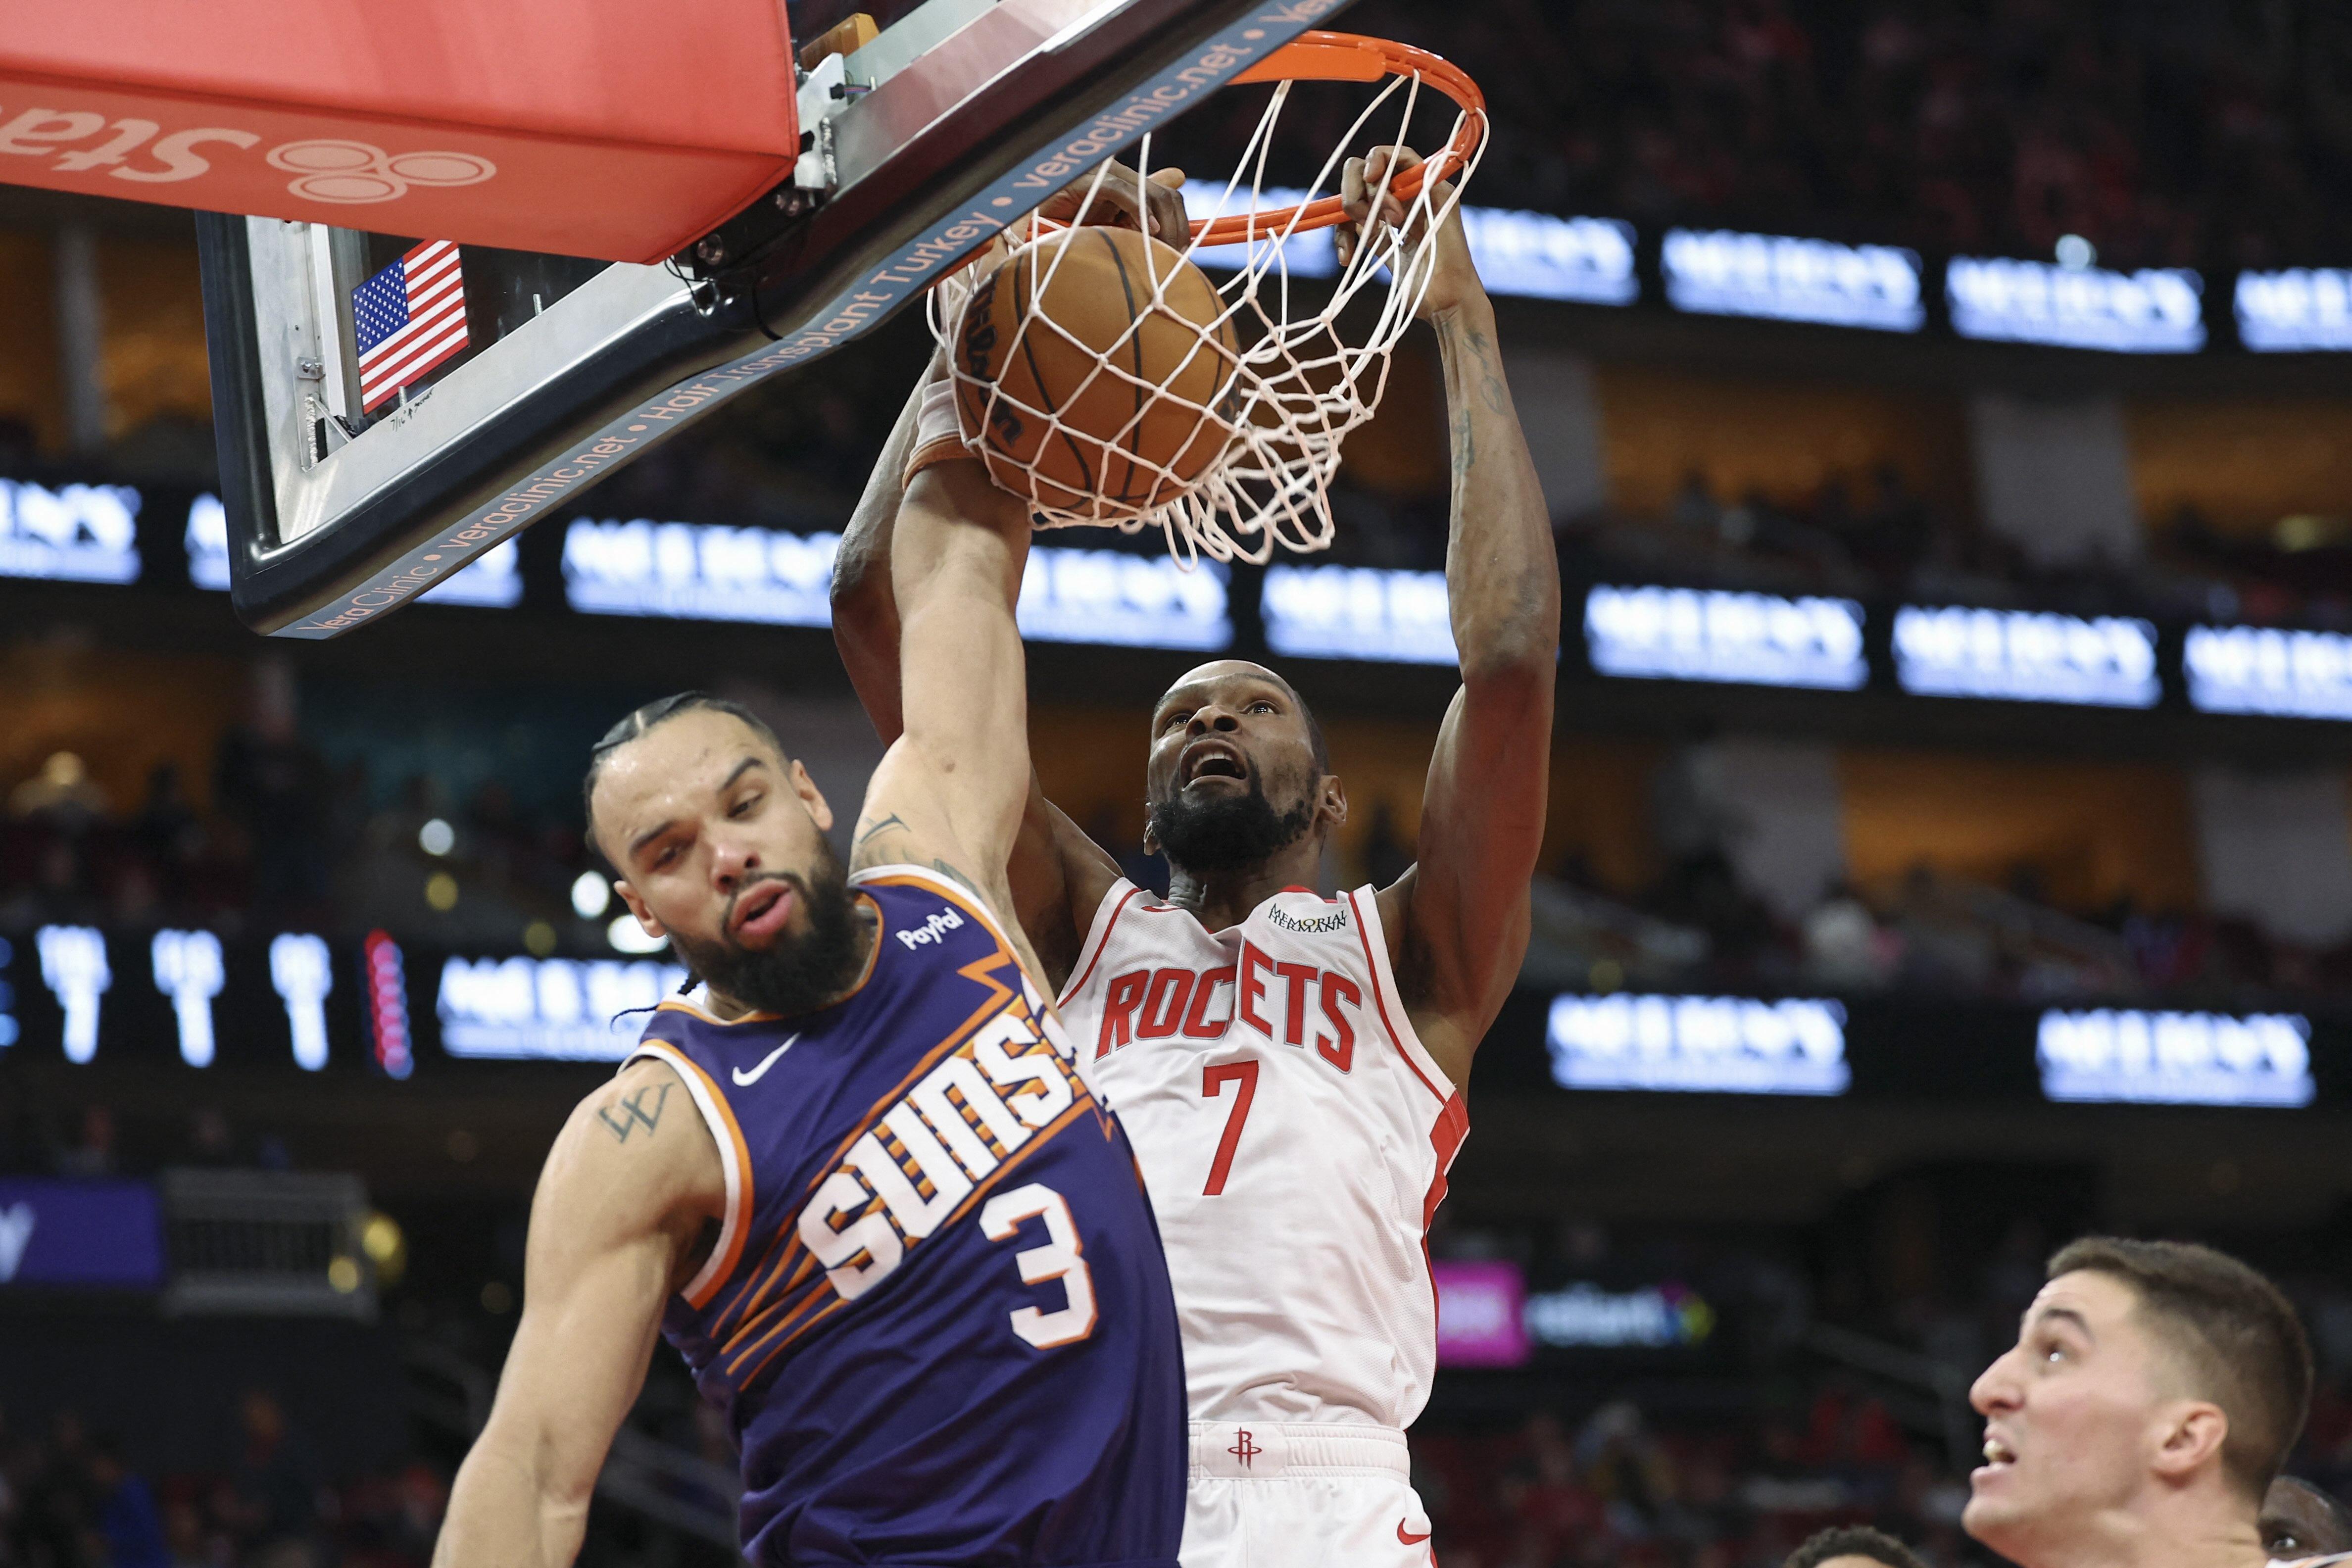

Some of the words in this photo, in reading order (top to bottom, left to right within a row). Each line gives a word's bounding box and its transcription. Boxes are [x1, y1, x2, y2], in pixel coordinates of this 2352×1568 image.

[0, 105, 261, 183] Sta
[438, 436, 638, 548] veraclinic.net
[639, 382, 720, 420] Hair
[703, 290, 892, 380] Transplant
[870, 211, 1004, 283] Turkey
[1013, 43, 1253, 188] veraclinic.net
[895, 906, 965, 951] PayPal
[1268, 909, 1346, 933] HERMANN
[1271, 903, 1347, 927] MEMORIAL
[1094, 937, 1363, 1075] ROCETS
[797, 1012, 1074, 1302] SUNS
[1202, 1060, 1260, 1196] 7
[979, 1183, 1099, 1350] 3
